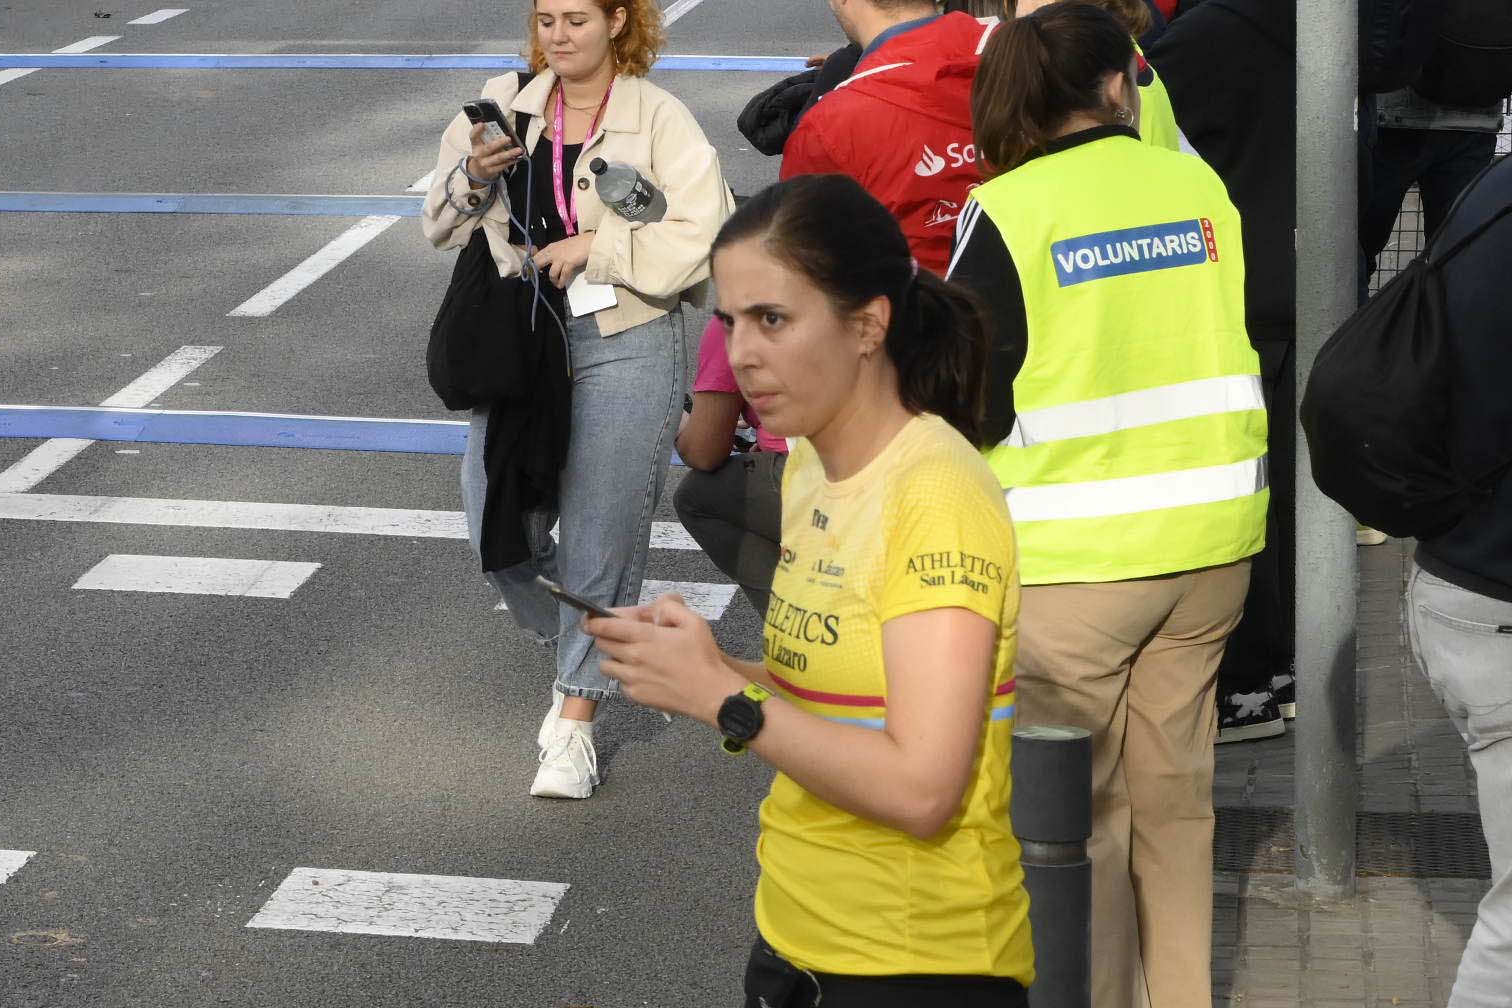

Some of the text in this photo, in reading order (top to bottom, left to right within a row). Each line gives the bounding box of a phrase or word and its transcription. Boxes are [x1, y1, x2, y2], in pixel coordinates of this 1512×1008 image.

[1056, 231, 1202, 274] VOLUNTARIS
[905, 551, 1002, 585] ATHLETICS
[920, 572, 945, 586] San
